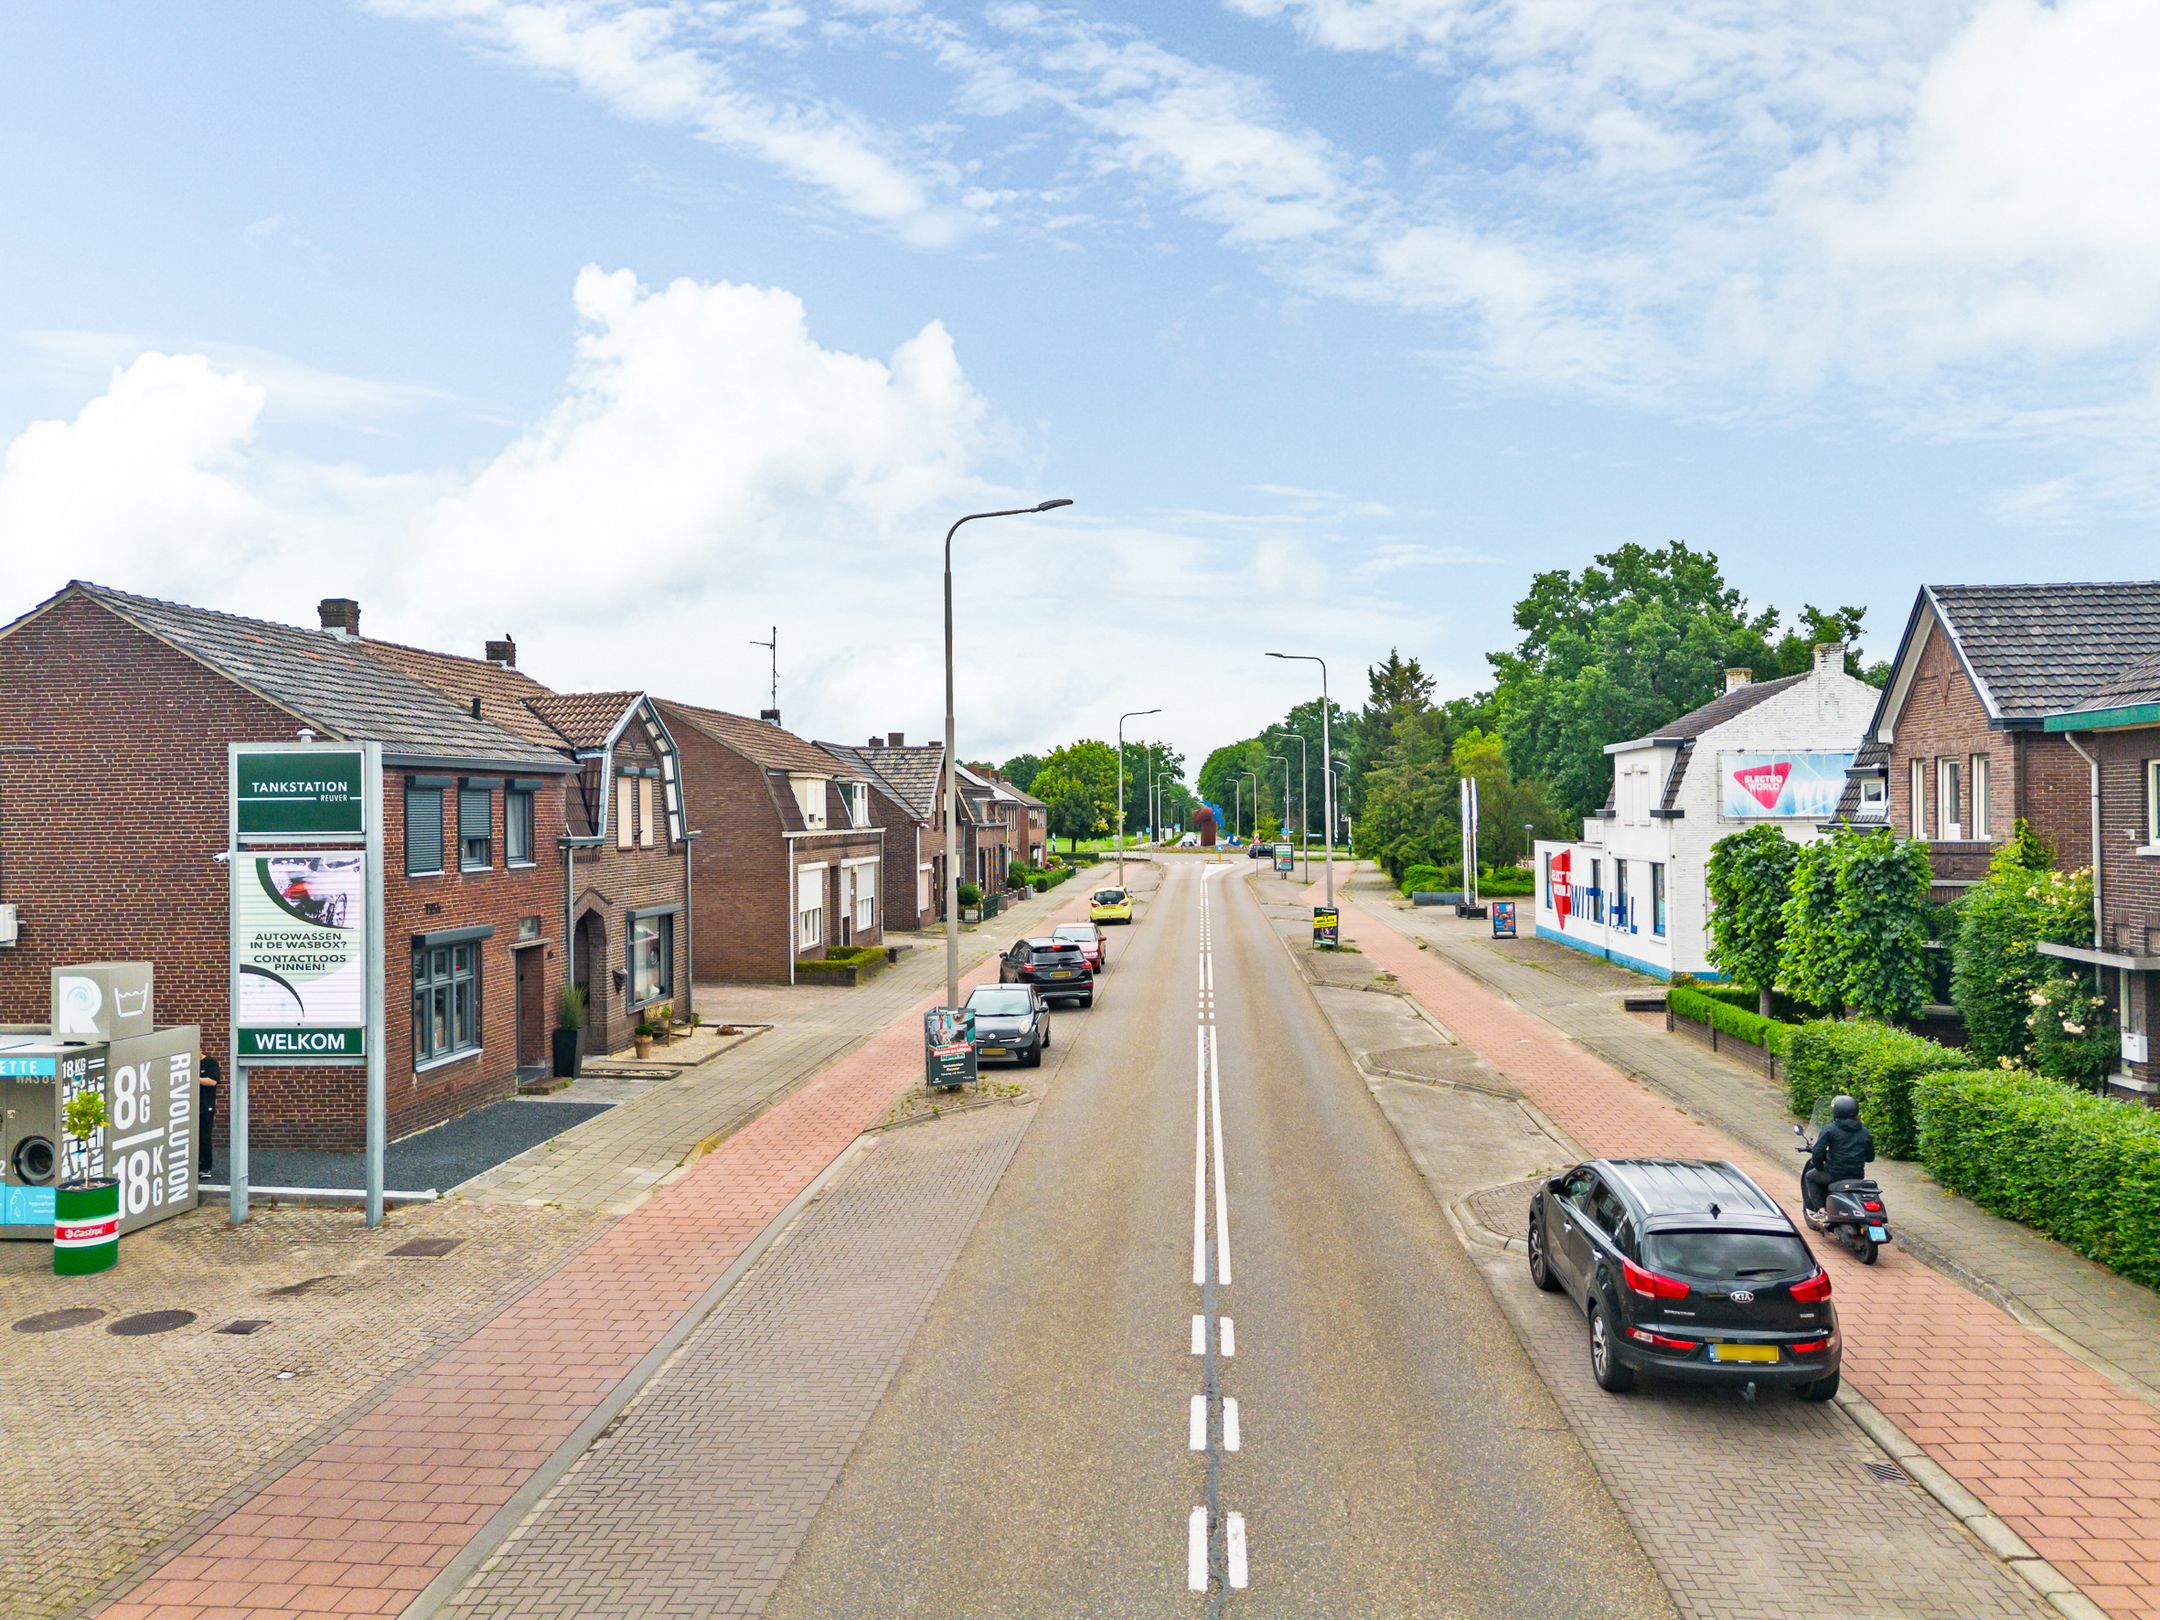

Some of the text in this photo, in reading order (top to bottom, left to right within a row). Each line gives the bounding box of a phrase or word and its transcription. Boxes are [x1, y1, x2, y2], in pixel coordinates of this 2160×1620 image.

[1744, 775, 1783, 783] ELECTRO
[252, 781, 348, 793] TANKSTATION
[1747, 783, 1780, 791] WORLD
[320, 794, 348, 802] REUVER
[255, 932, 342, 941] AUTOWASSEN
[285, 941, 347, 949] WASBOX?
[253, 954, 346, 963] CONTACTLOOS
[274, 963, 325, 971] PINNEN!
[255, 1033, 345, 1050] WELKOM
[167, 1052, 191, 1204] REVOLUTION
[73, 1226, 103, 1238] Castrol
[1734, 1293, 1750, 1301] KIA
